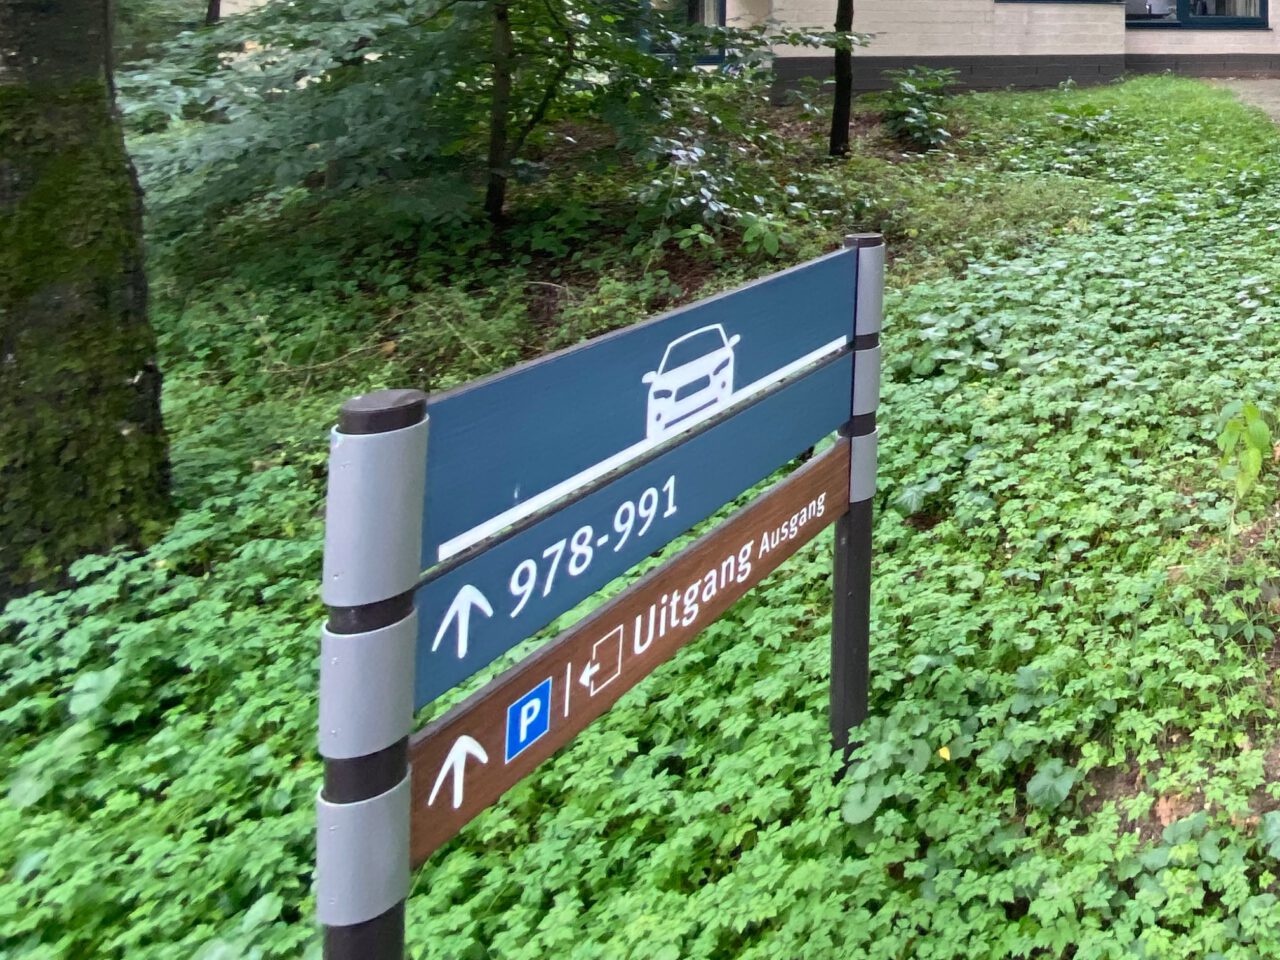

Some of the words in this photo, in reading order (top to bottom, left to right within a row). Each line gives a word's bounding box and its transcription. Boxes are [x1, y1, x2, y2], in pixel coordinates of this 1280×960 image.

[510, 475, 677, 618] 978-991
[520, 698, 541, 743] P
[634, 540, 754, 654] Uitgang
[758, 492, 826, 559] Ausgang
